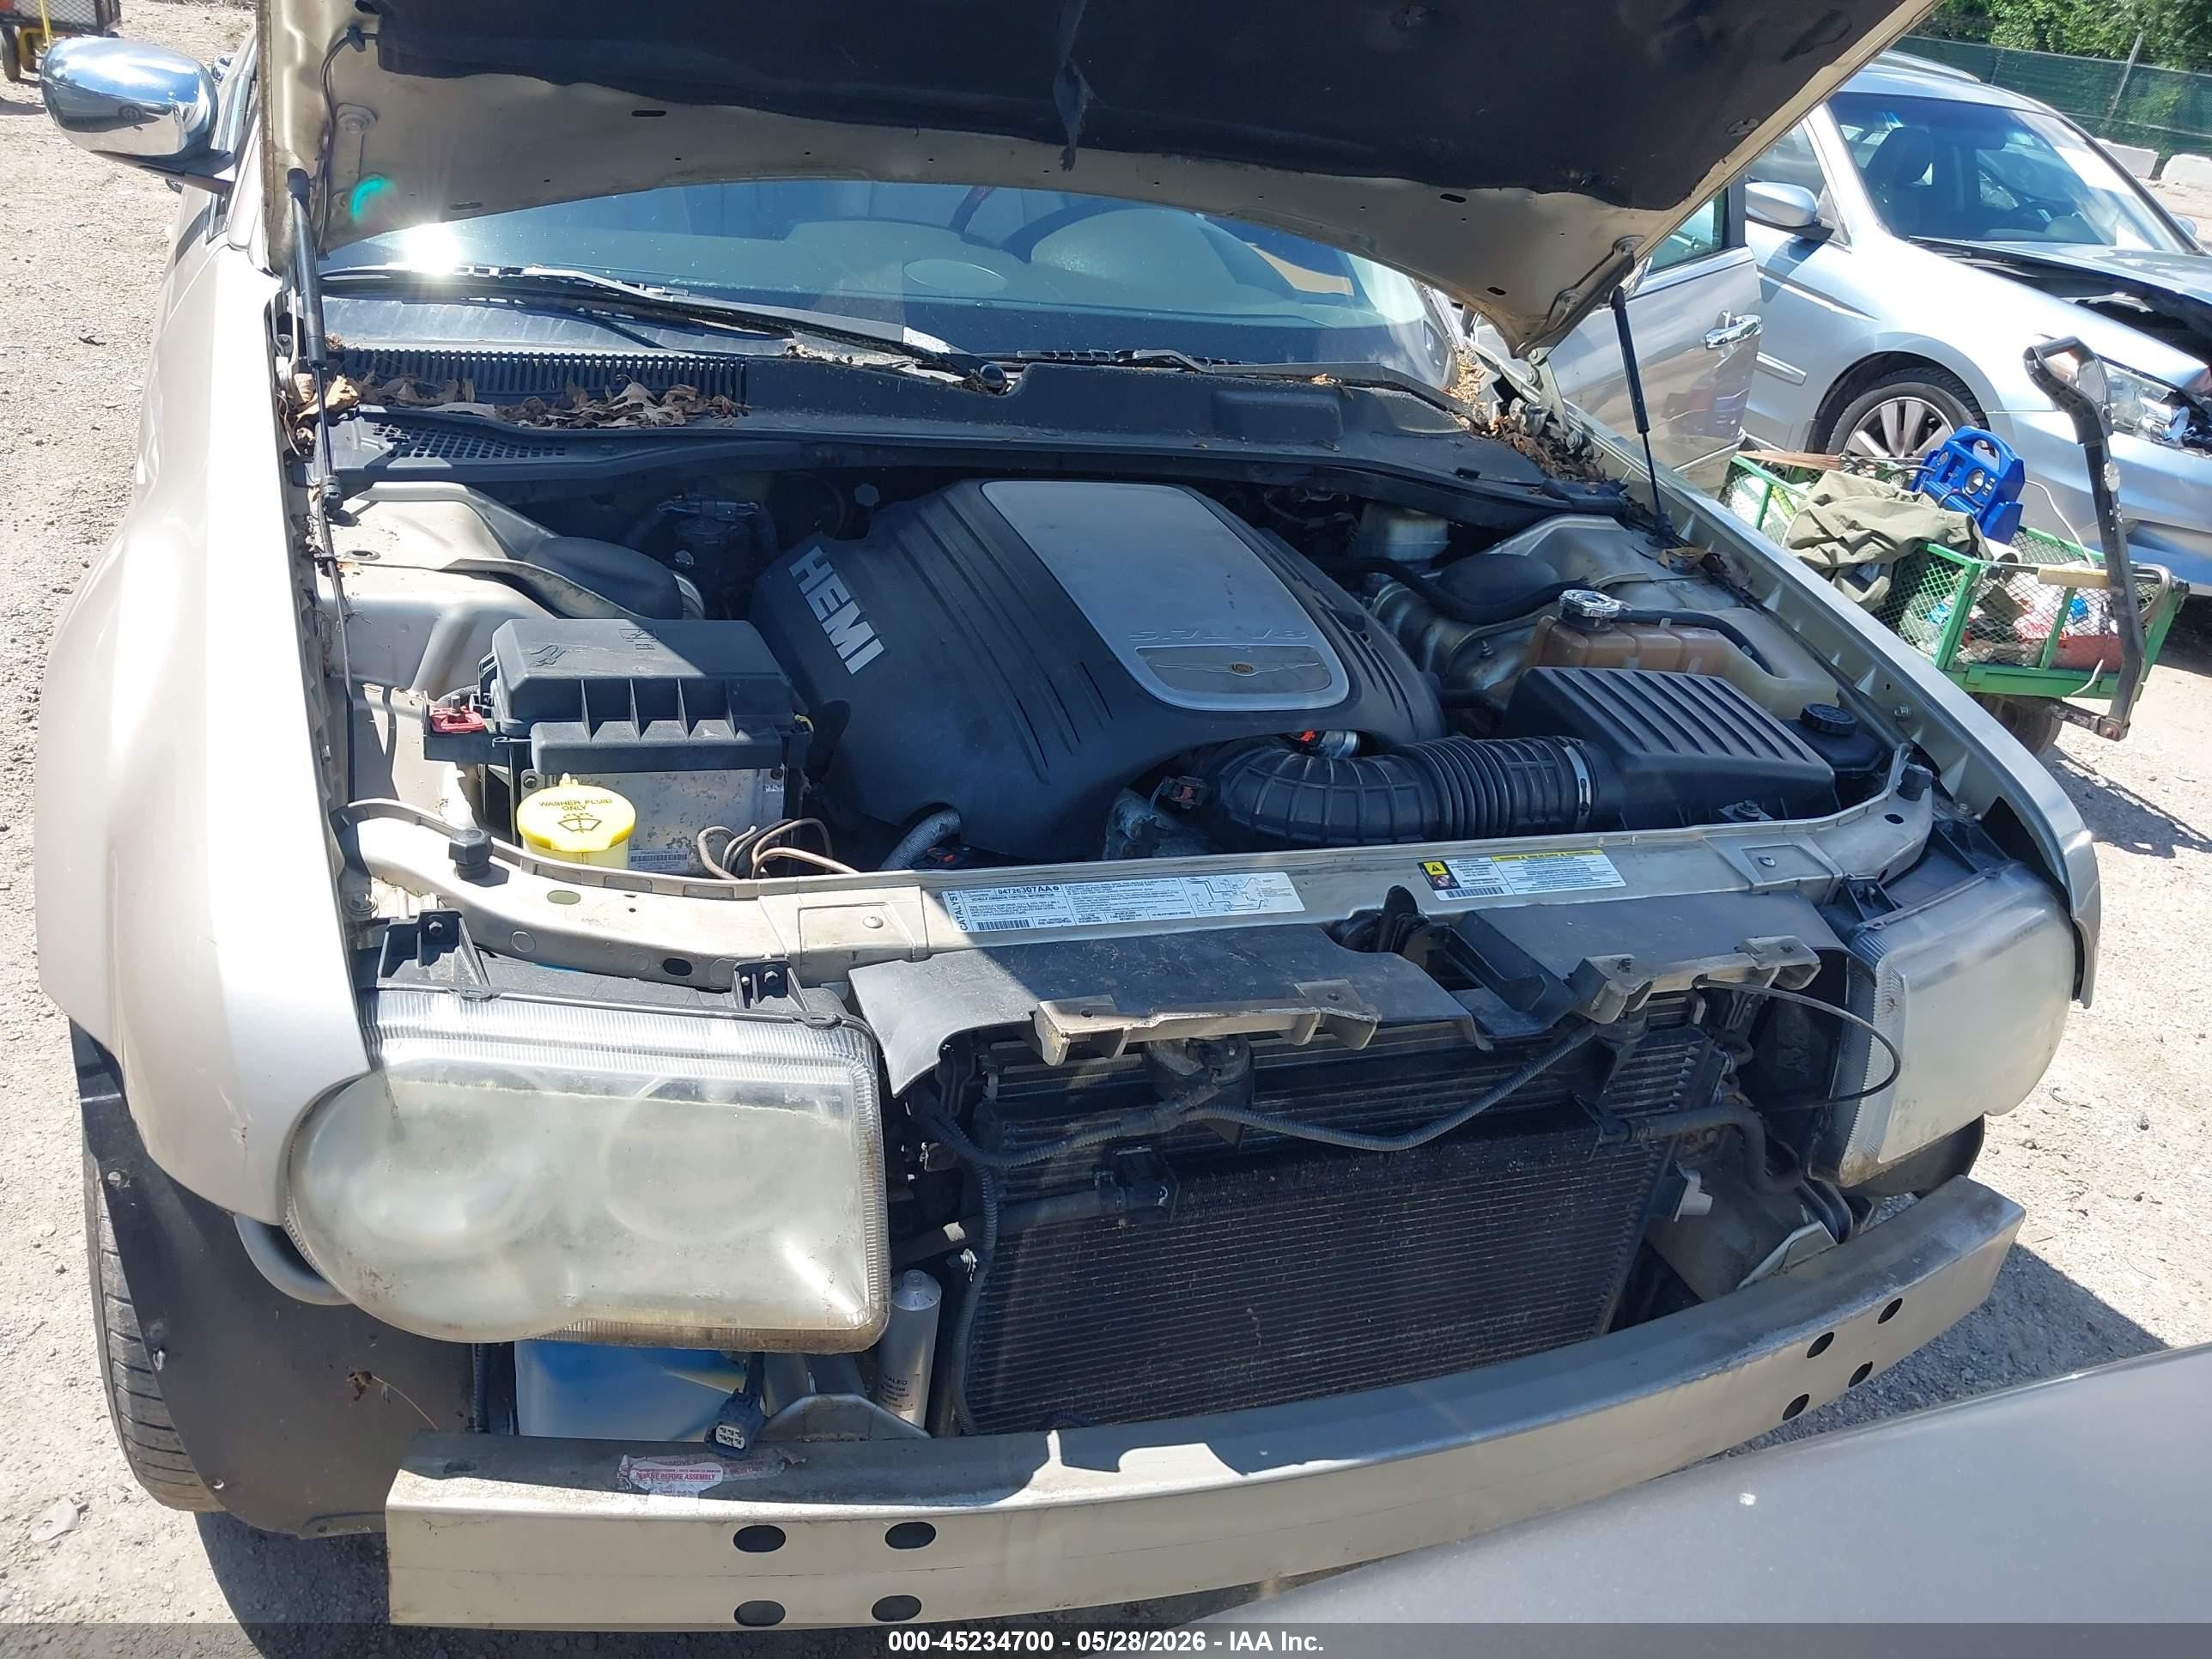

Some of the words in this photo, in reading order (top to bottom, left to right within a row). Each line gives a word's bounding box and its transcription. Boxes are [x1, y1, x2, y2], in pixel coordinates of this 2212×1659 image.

[788, 545, 885, 675] HEMI
[1250, 629, 1309, 640] V8
[947, 891, 969, 932] CATALYST
[660, 1472, 685, 1480] BEFORE
[685, 1472, 716, 1480] ASSEMBLY
